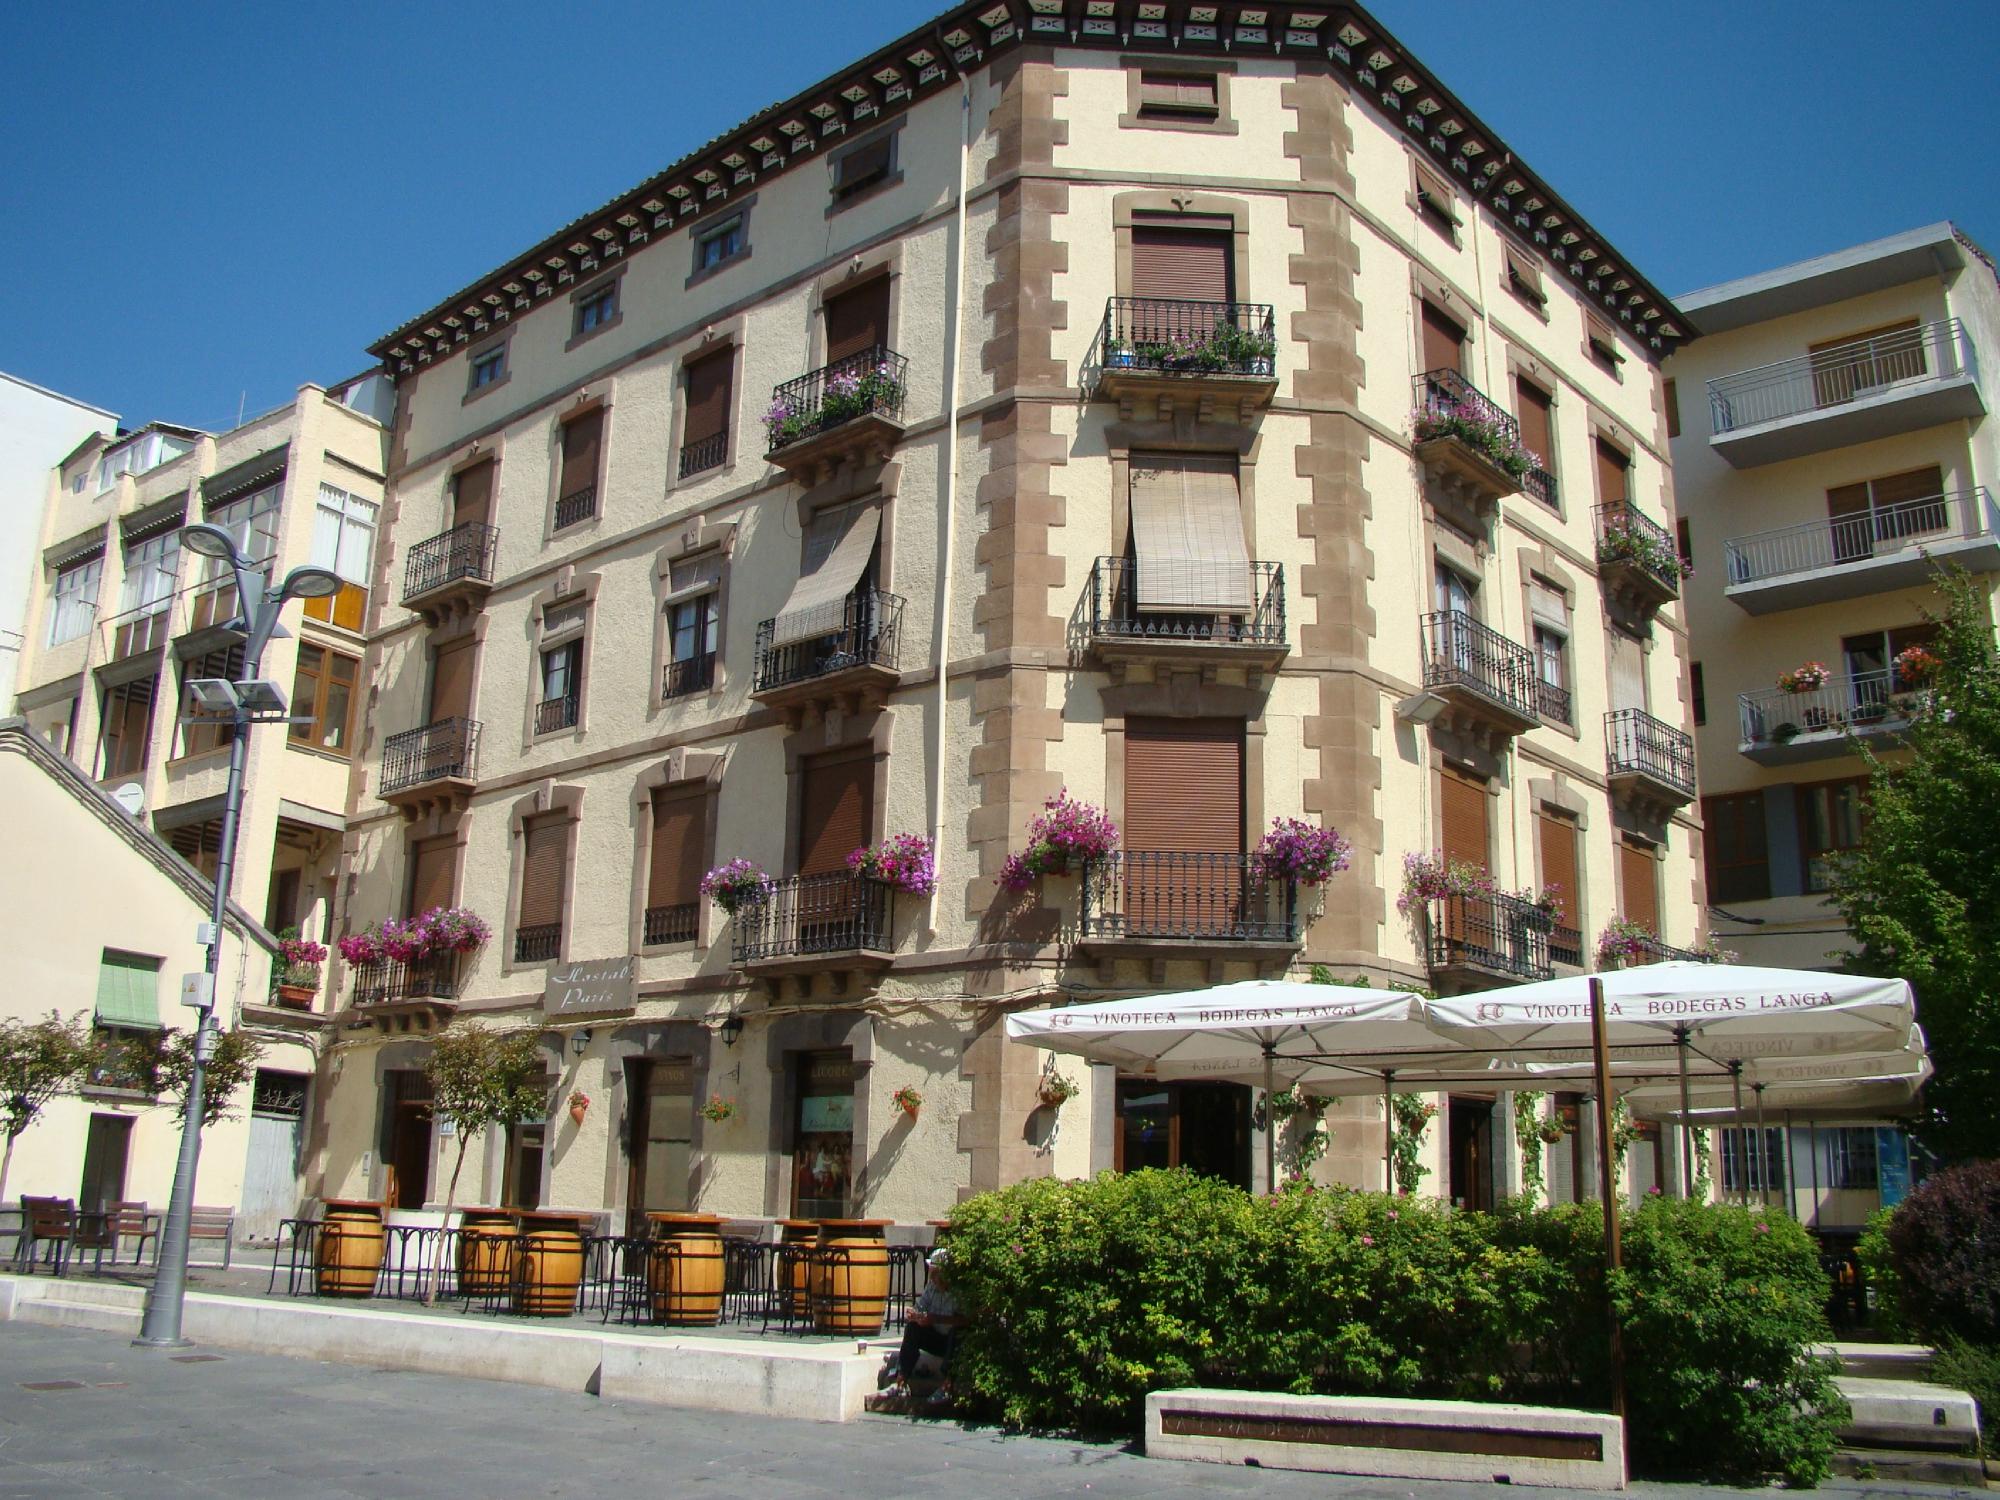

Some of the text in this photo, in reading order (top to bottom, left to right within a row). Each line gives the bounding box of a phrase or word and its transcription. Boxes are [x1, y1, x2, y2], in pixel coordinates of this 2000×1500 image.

[552, 965, 629, 984] Hostal
[1524, 991, 1835, 1018] VINOTEA BODEGAS LANGA
[1093, 1006, 1358, 1024] VINOTECA BODEGAS LANGA
